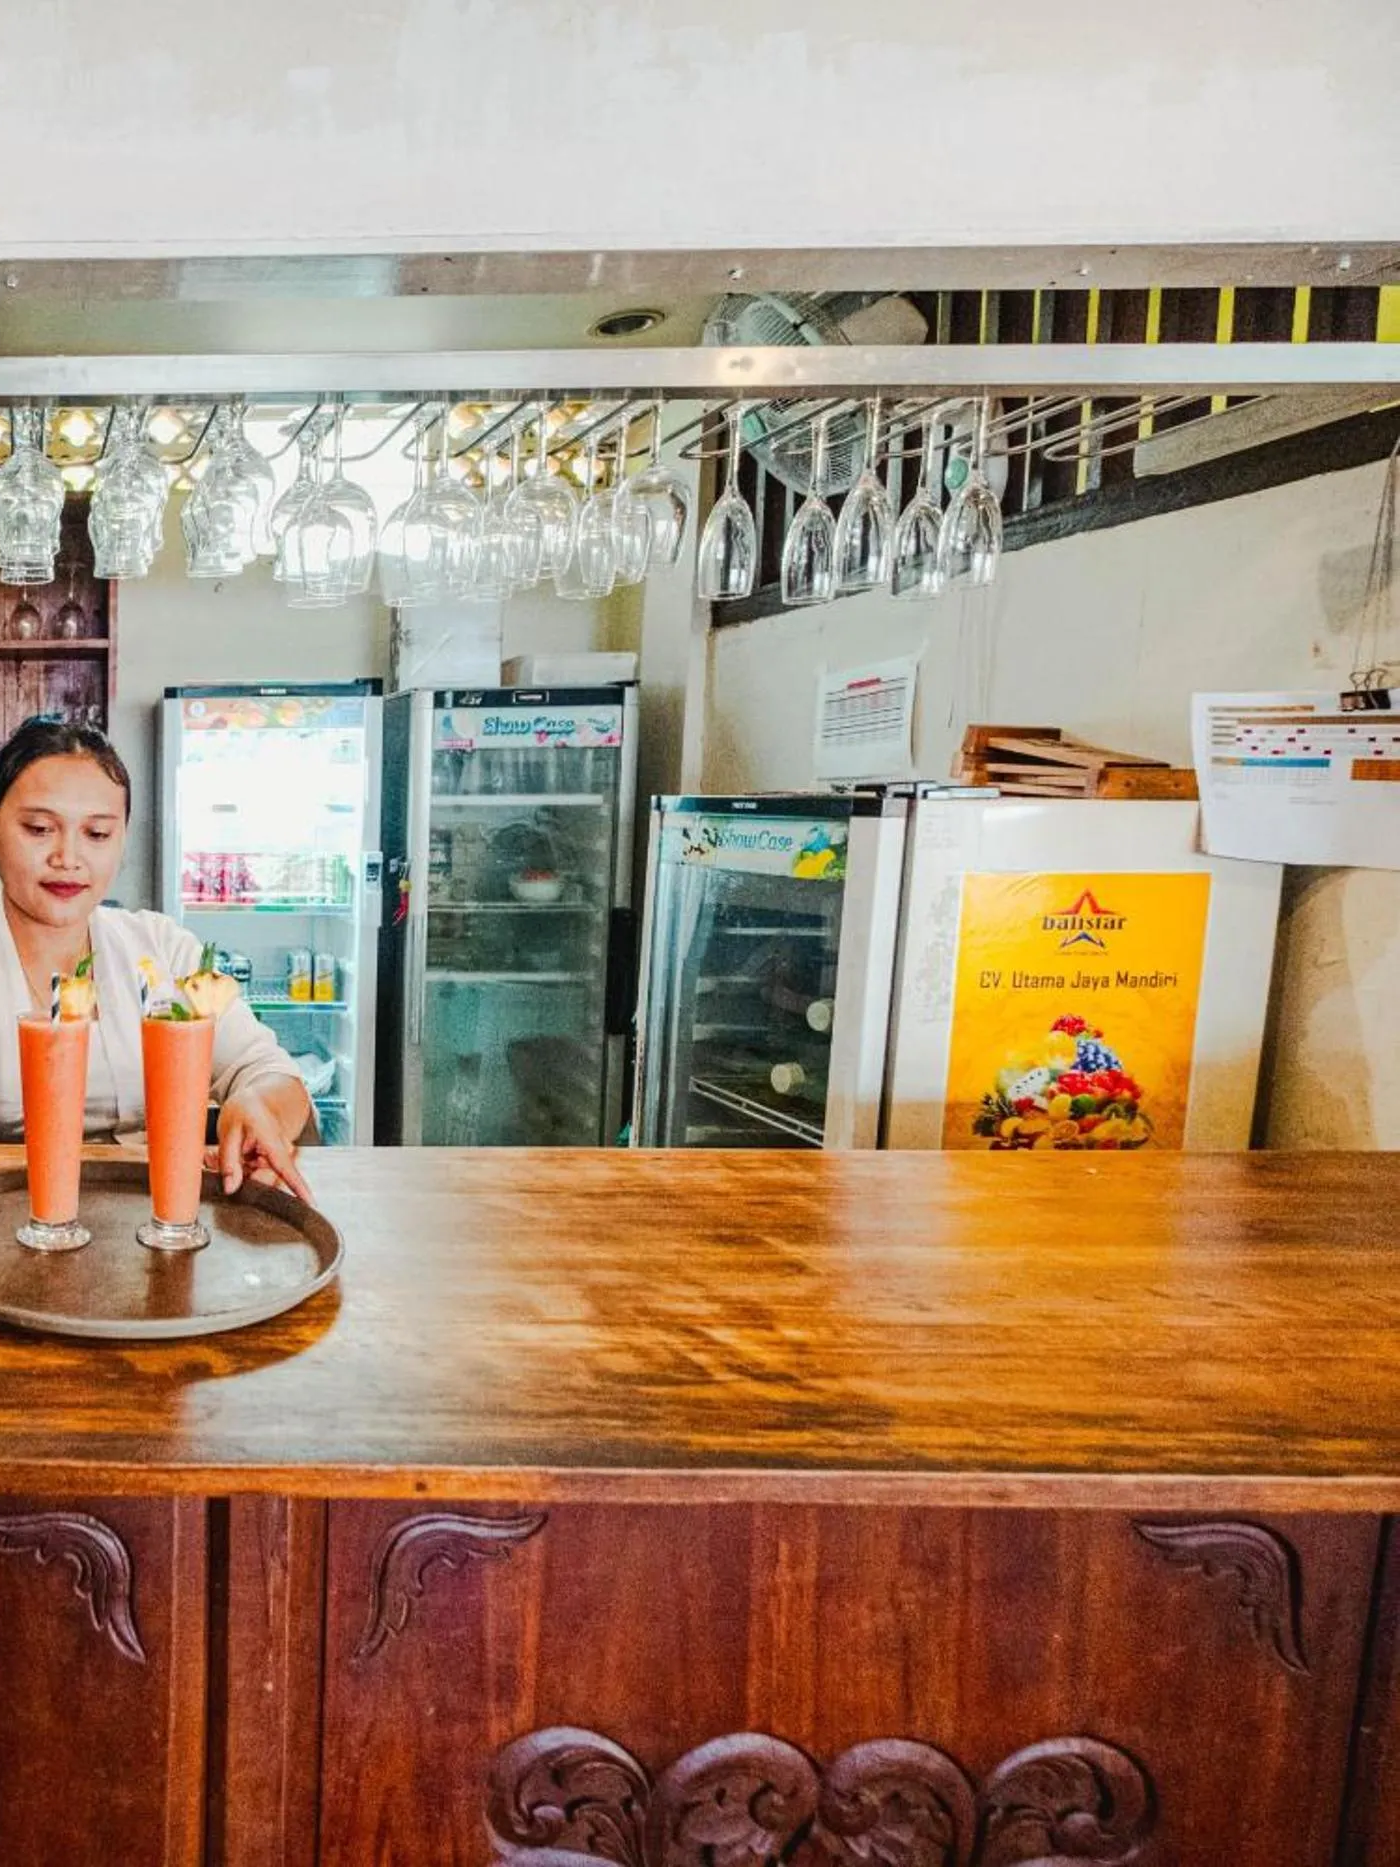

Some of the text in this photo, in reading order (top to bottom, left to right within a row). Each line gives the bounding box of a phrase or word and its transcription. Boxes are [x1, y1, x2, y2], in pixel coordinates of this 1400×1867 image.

[1012, 970, 1065, 989] Utama
[1071, 970, 1110, 991] Jaya
[1116, 970, 1178, 989] Mandiri
